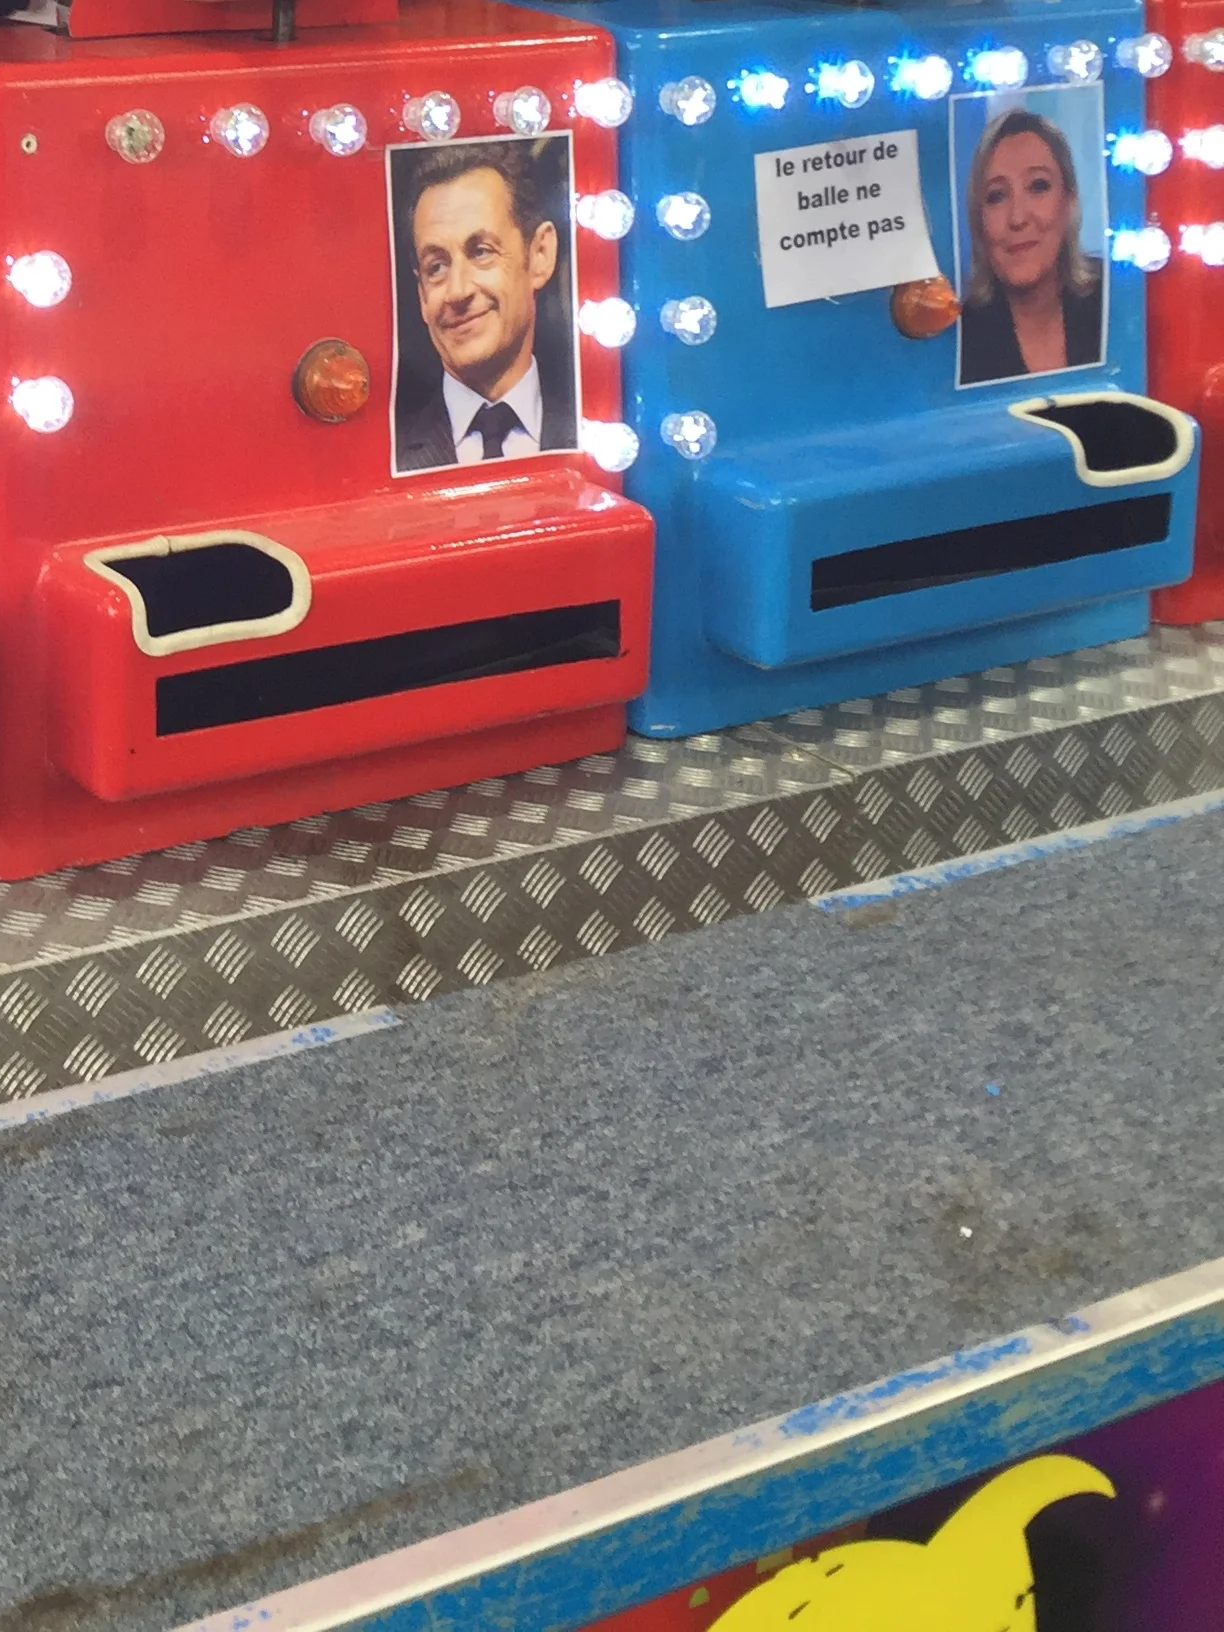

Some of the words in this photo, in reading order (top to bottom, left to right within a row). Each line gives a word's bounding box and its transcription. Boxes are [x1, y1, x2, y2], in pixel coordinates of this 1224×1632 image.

[776, 158, 795, 178] le
[802, 148, 866, 174] retour
[873, 141, 898, 161] de
[798, 186, 849, 211] balle
[856, 183, 881, 200] ne
[780, 221, 860, 250] compte
[867, 215, 905, 241] pas
